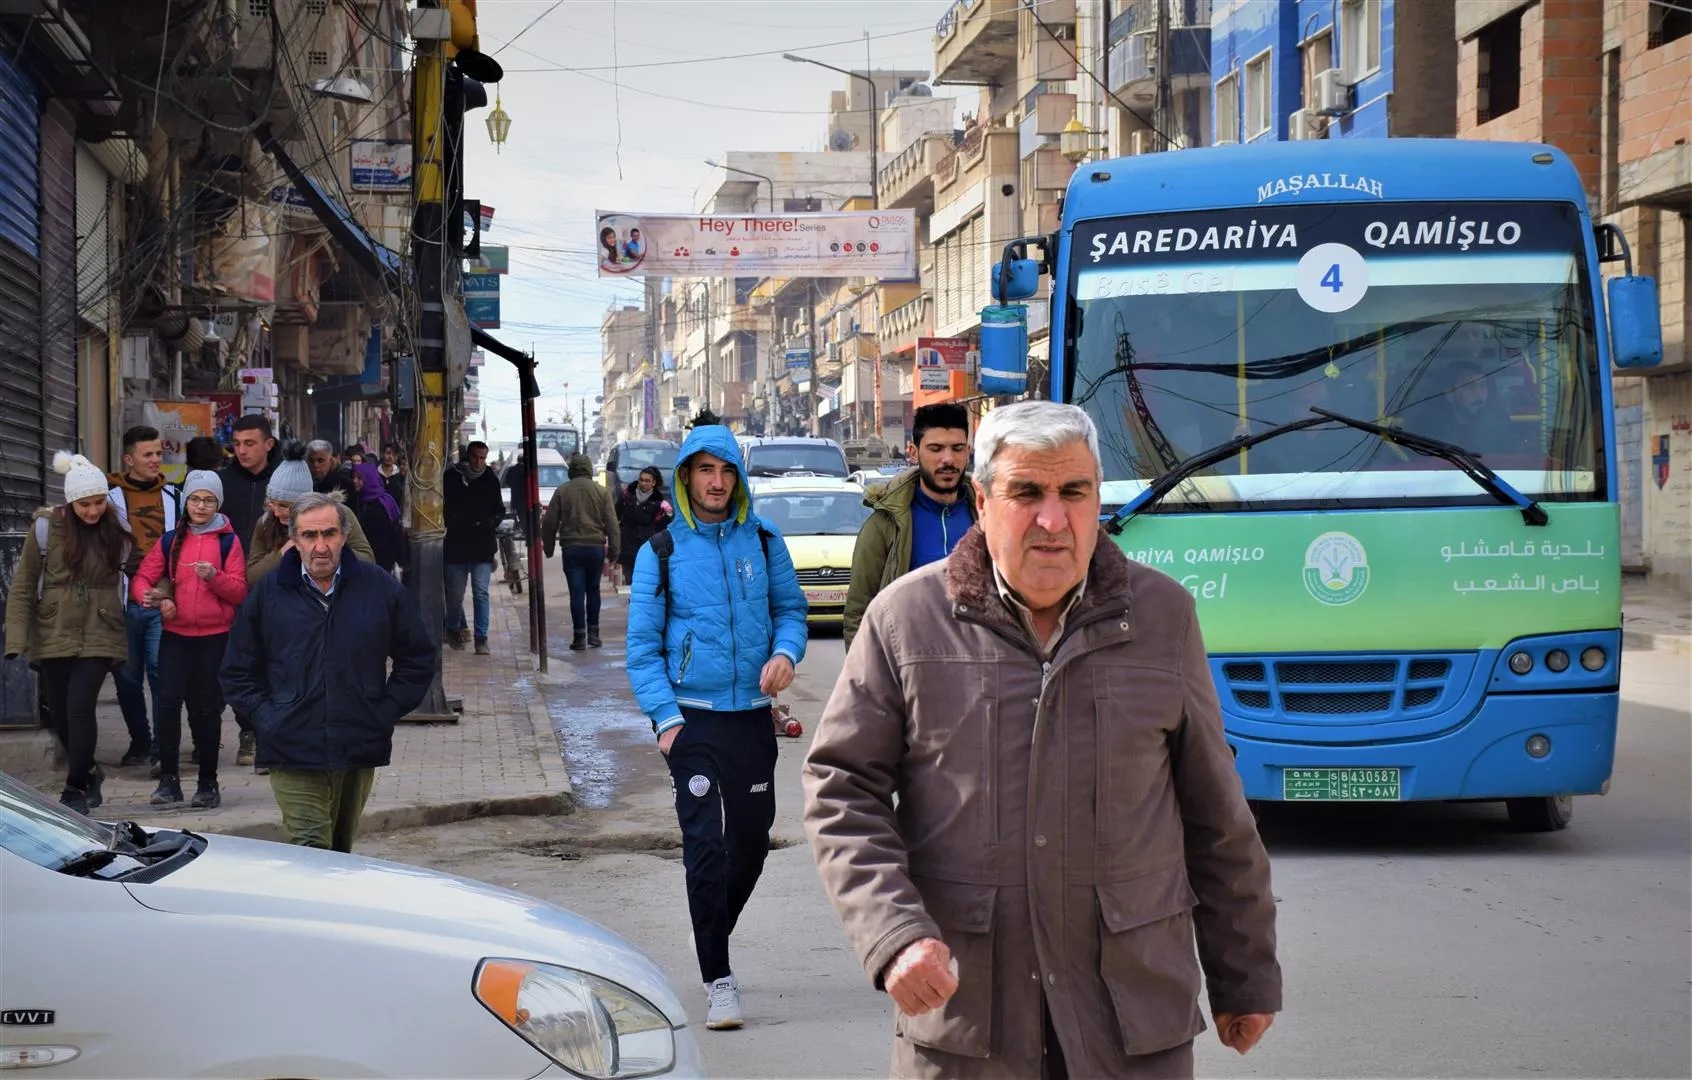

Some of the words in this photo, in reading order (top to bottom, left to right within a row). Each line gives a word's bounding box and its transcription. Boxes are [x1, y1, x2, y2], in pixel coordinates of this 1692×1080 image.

[1257, 173, 1384, 203] MAŞALLAH
[700, 217, 735, 236] Hey
[741, 217, 798, 232] There!
[799, 224, 826, 232] Series
[1090, 219, 1298, 263] ŞAREDARİYA
[1364, 215, 1521, 251] QAMİŞLO
[1183, 264, 1237, 293] Gel
[1320, 263, 1343, 293] 4
[1126, 548, 1174, 564] ARİYA
[1183, 545, 1265, 565] QAMİŞLO
[1440, 538, 1535, 562] قامشلو
[1541, 540, 1604, 560] بلدية
[1453, 572, 1545, 595] الشعب
[1552, 575, 1600, 594] باص
[749, 781, 769, 793] NIKE
[1351, 771, 1397, 783] 430587
[3, 1012, 53, 1023] CVVT
